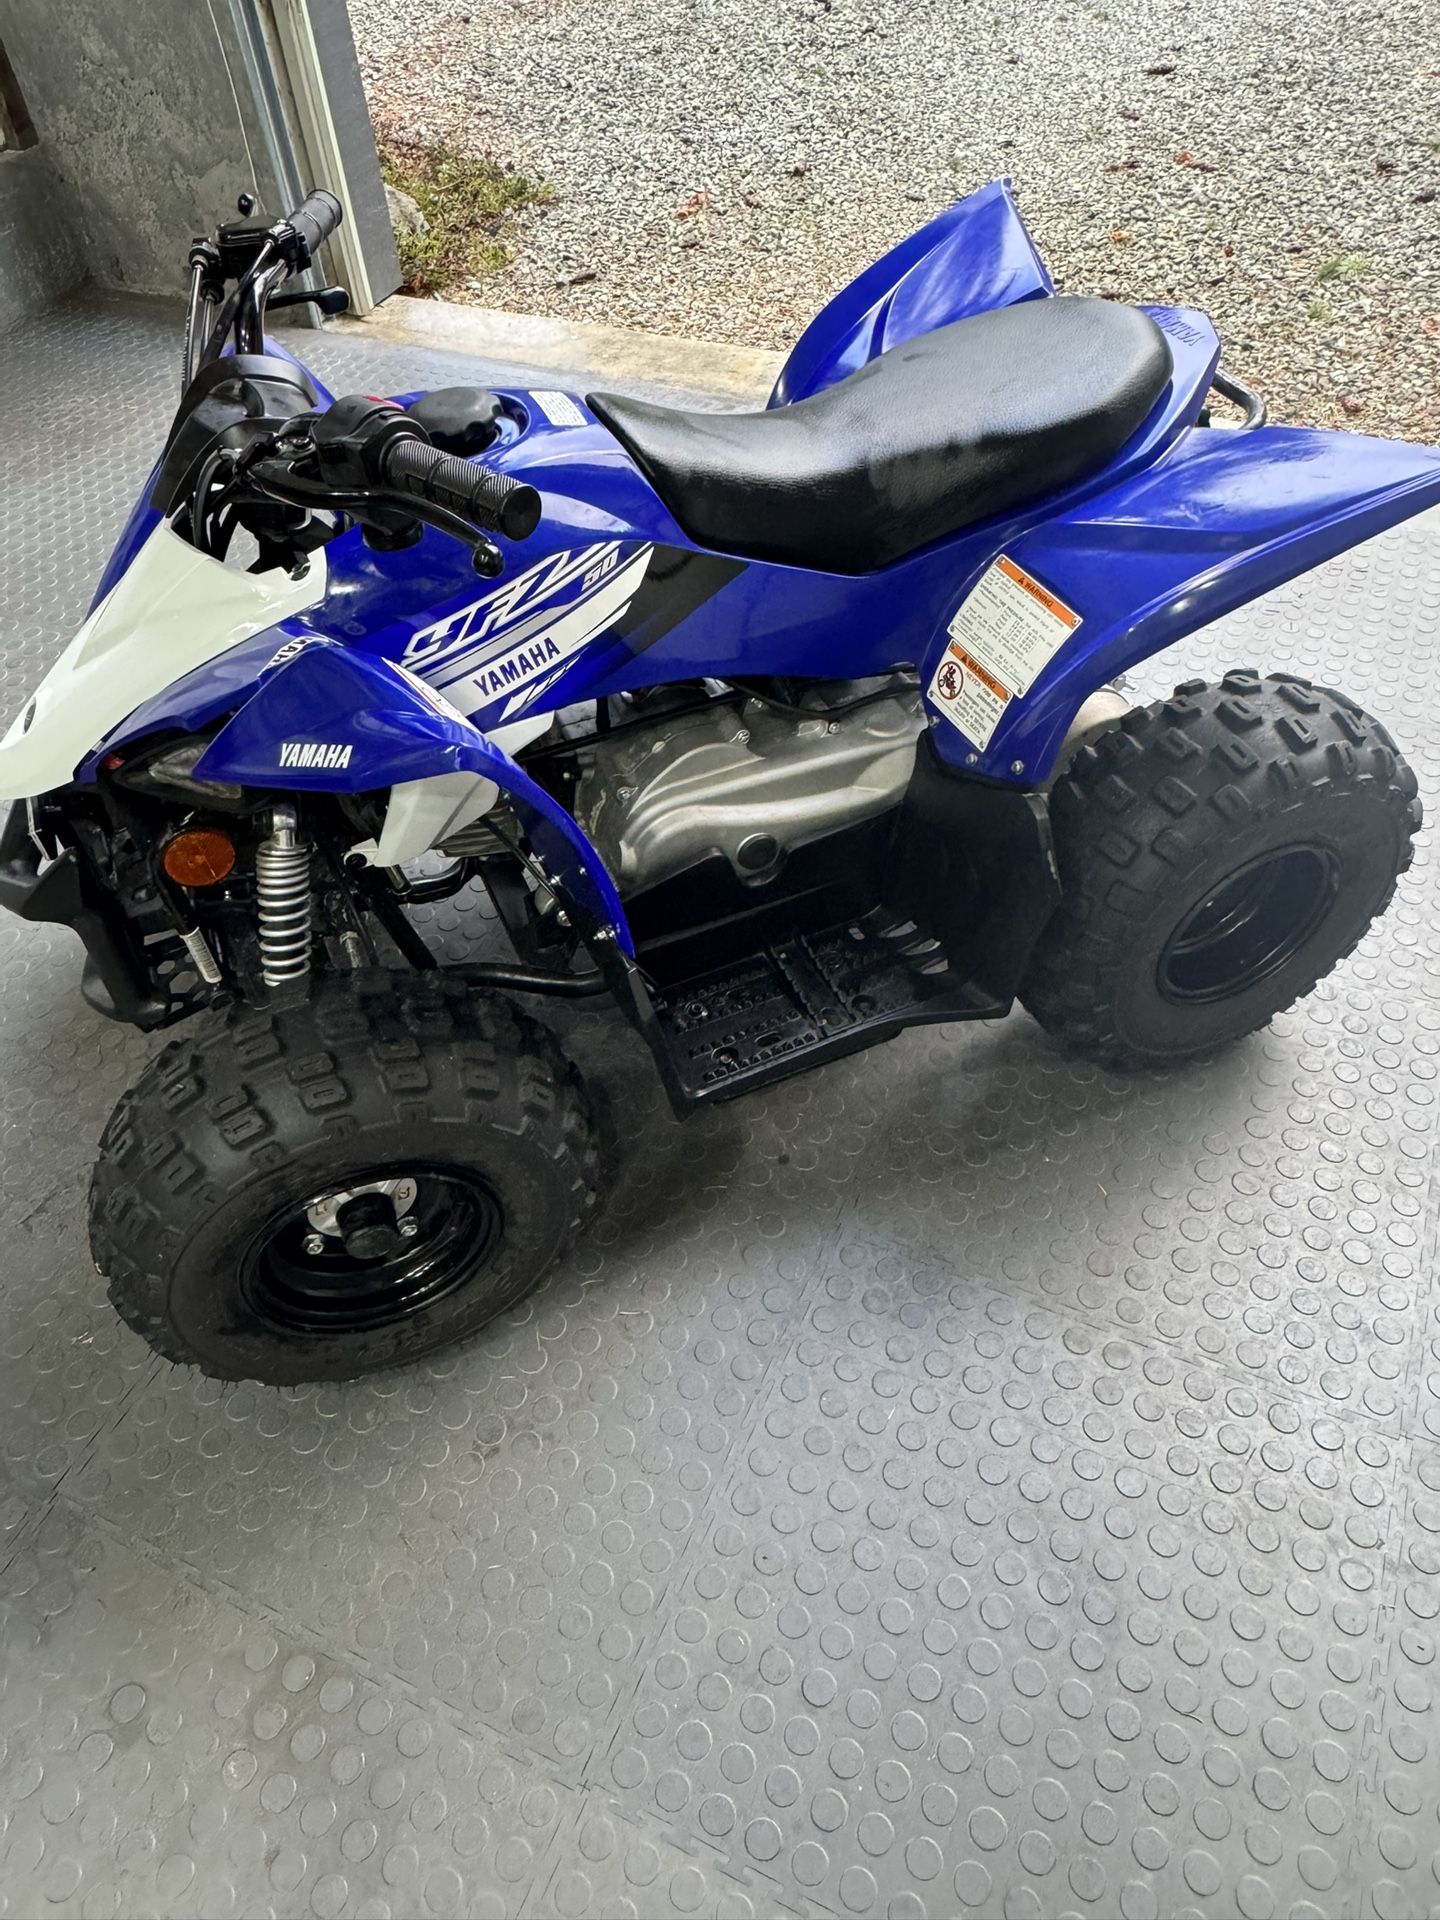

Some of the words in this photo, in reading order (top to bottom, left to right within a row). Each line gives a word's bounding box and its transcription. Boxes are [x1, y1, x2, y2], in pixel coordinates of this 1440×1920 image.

[580, 547, 620, 593] 50
[1023, 580, 1054, 609] WARNING
[472, 636, 561, 697] YAMAHA
[966, 659, 996, 690] WARNING
[279, 743, 354, 769] YAMAHA
